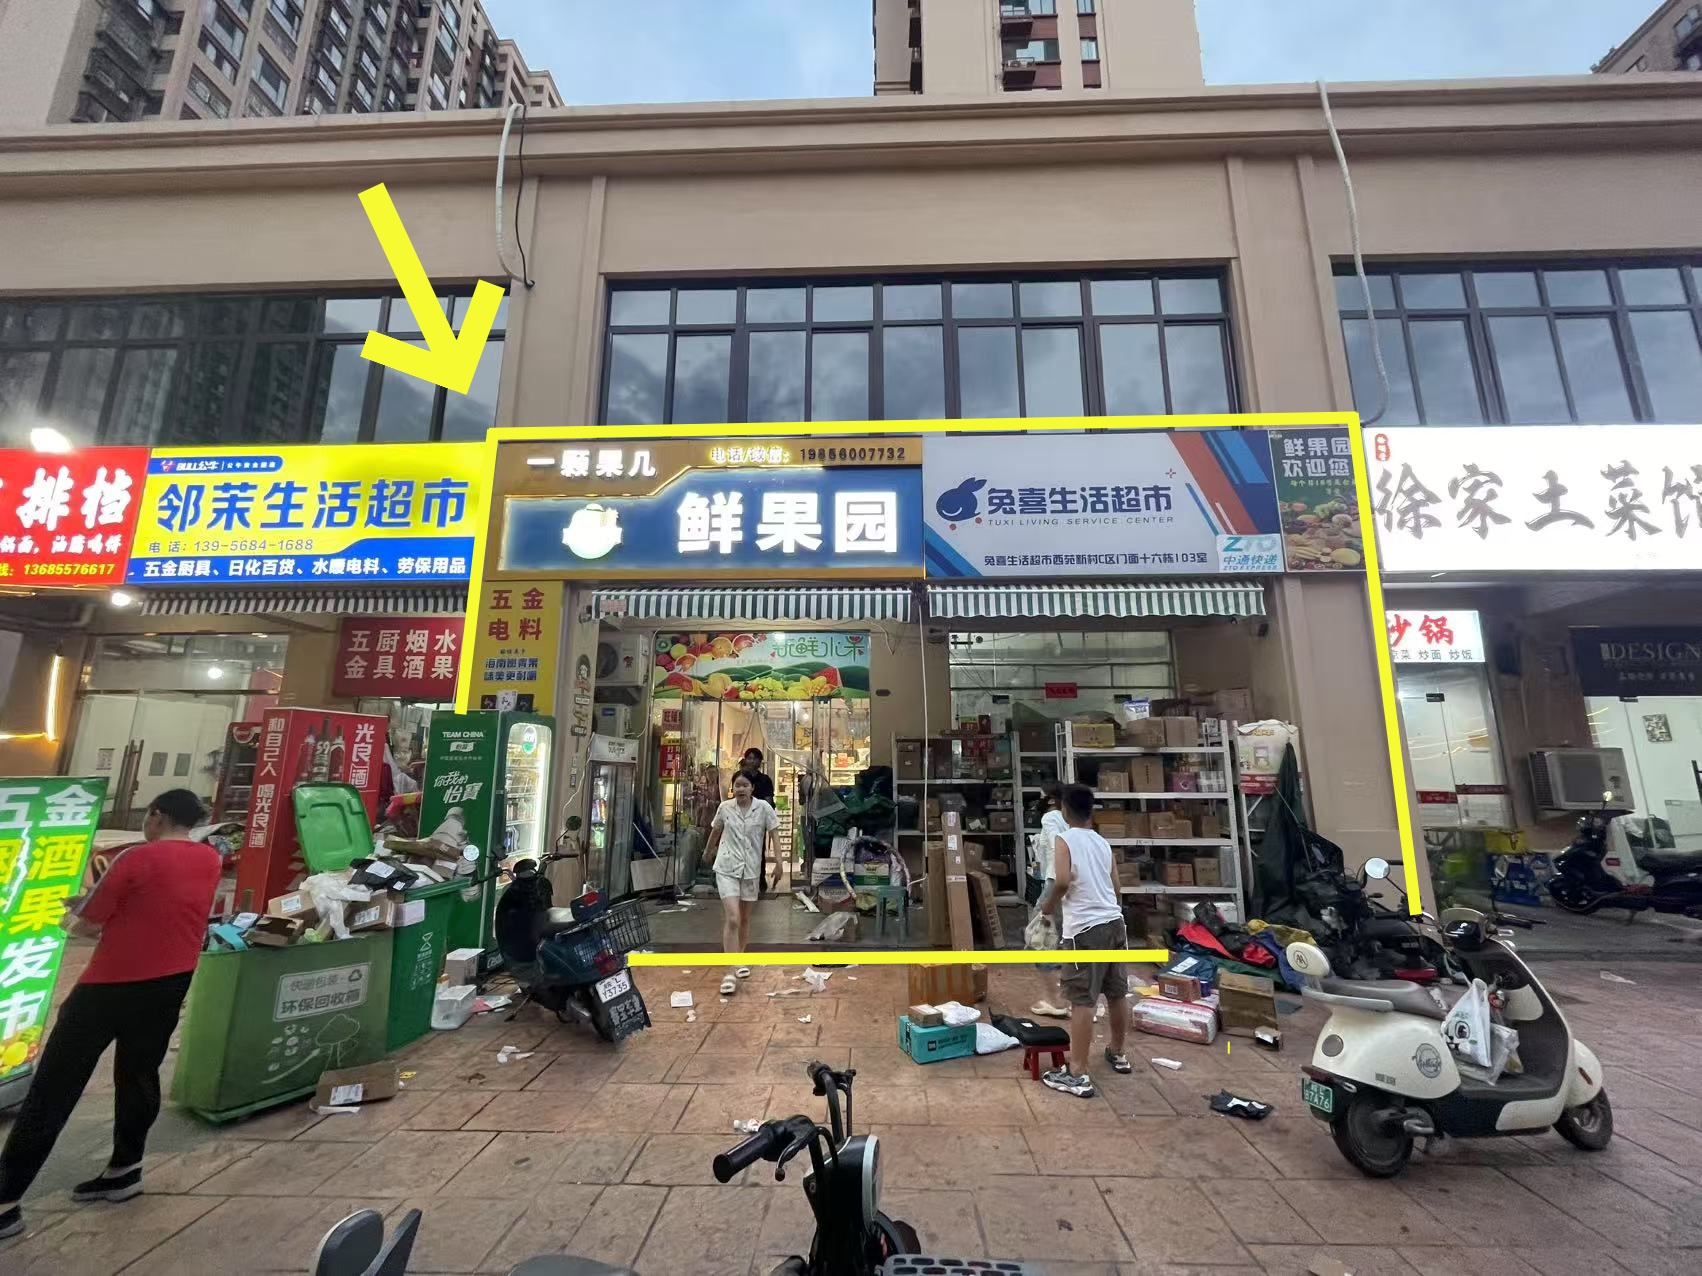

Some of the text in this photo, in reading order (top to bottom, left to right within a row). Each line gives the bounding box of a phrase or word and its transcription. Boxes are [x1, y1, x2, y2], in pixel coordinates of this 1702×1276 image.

[801, 447, 905, 461] 19856007732
[1283, 437, 1353, 457] 鲜果园
[1282, 458, 1350, 477] 欢迎您
[0, 466, 133, 532] 排档
[157, 478, 469, 532] 邻茉生活超市
[988, 485, 1172, 515] 兔喜生活超市
[677, 491, 898, 554] 鲜果园
[1019, 518, 1059, 526] LIVING
[1067, 517, 1118, 525] SERVICE
[1126, 516, 1174, 524] CENTER
[1223, 553, 1278, 565] 中通快递
[489, 587, 545, 609] 五金
[488, 617, 543, 641] 电料
[1418, 650, 1442, 660] 炒面
[1448, 650, 1473, 660] 炒饭
[348, 722, 376, 788] 光良酒
[0, 784, 99, 829] 五金
